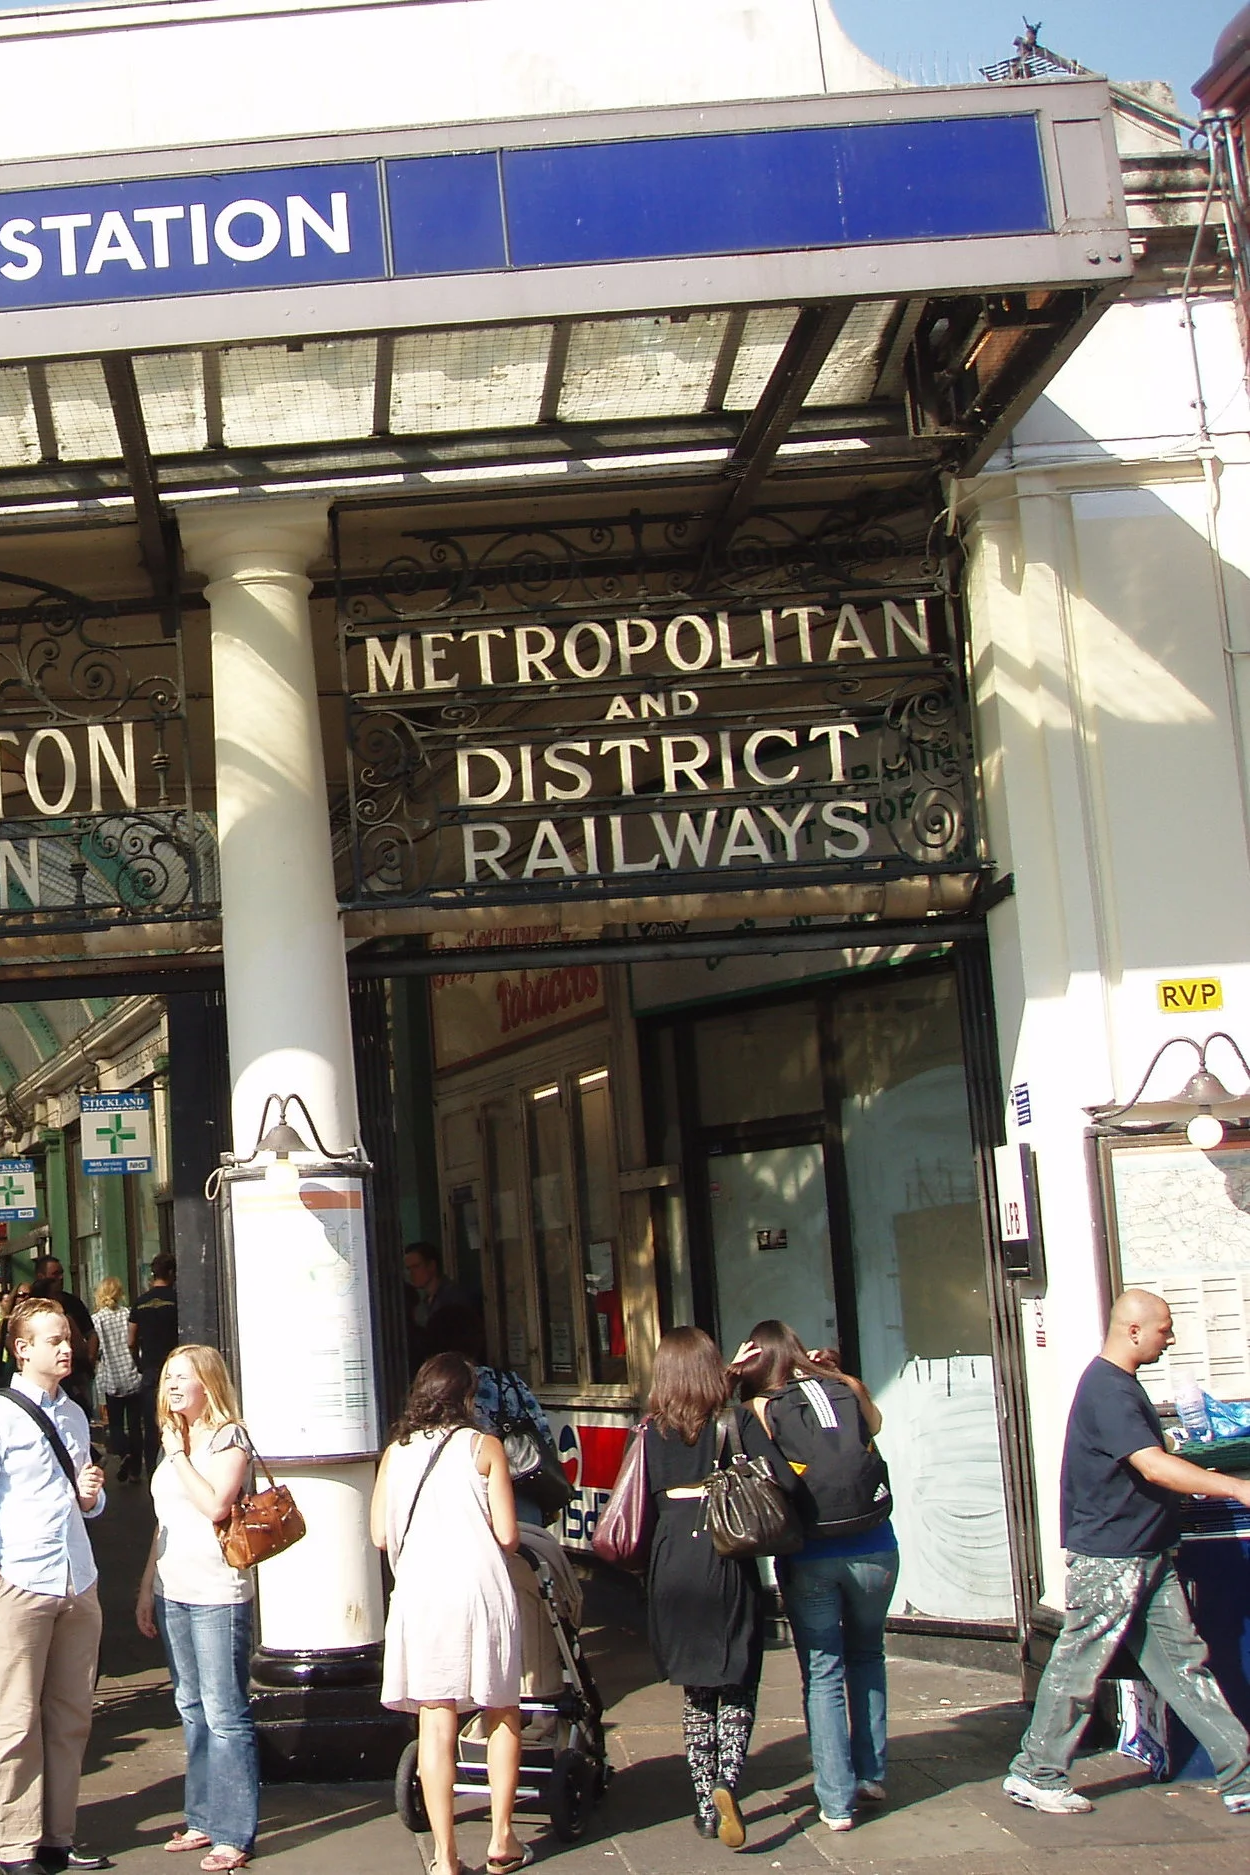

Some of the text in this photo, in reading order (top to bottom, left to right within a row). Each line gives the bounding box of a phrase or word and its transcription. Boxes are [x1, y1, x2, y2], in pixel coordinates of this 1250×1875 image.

[365, 599, 932, 694] METROPOLITAN
[604, 689, 700, 721] AND
[456, 724, 861, 807] DISTRICT
[462, 801, 871, 884] RAILWAYS
[1161, 983, 1217, 1008] RVP
[82, 1098, 145, 1108] STICKLAND
[129, 1161, 146, 1169] NHS
